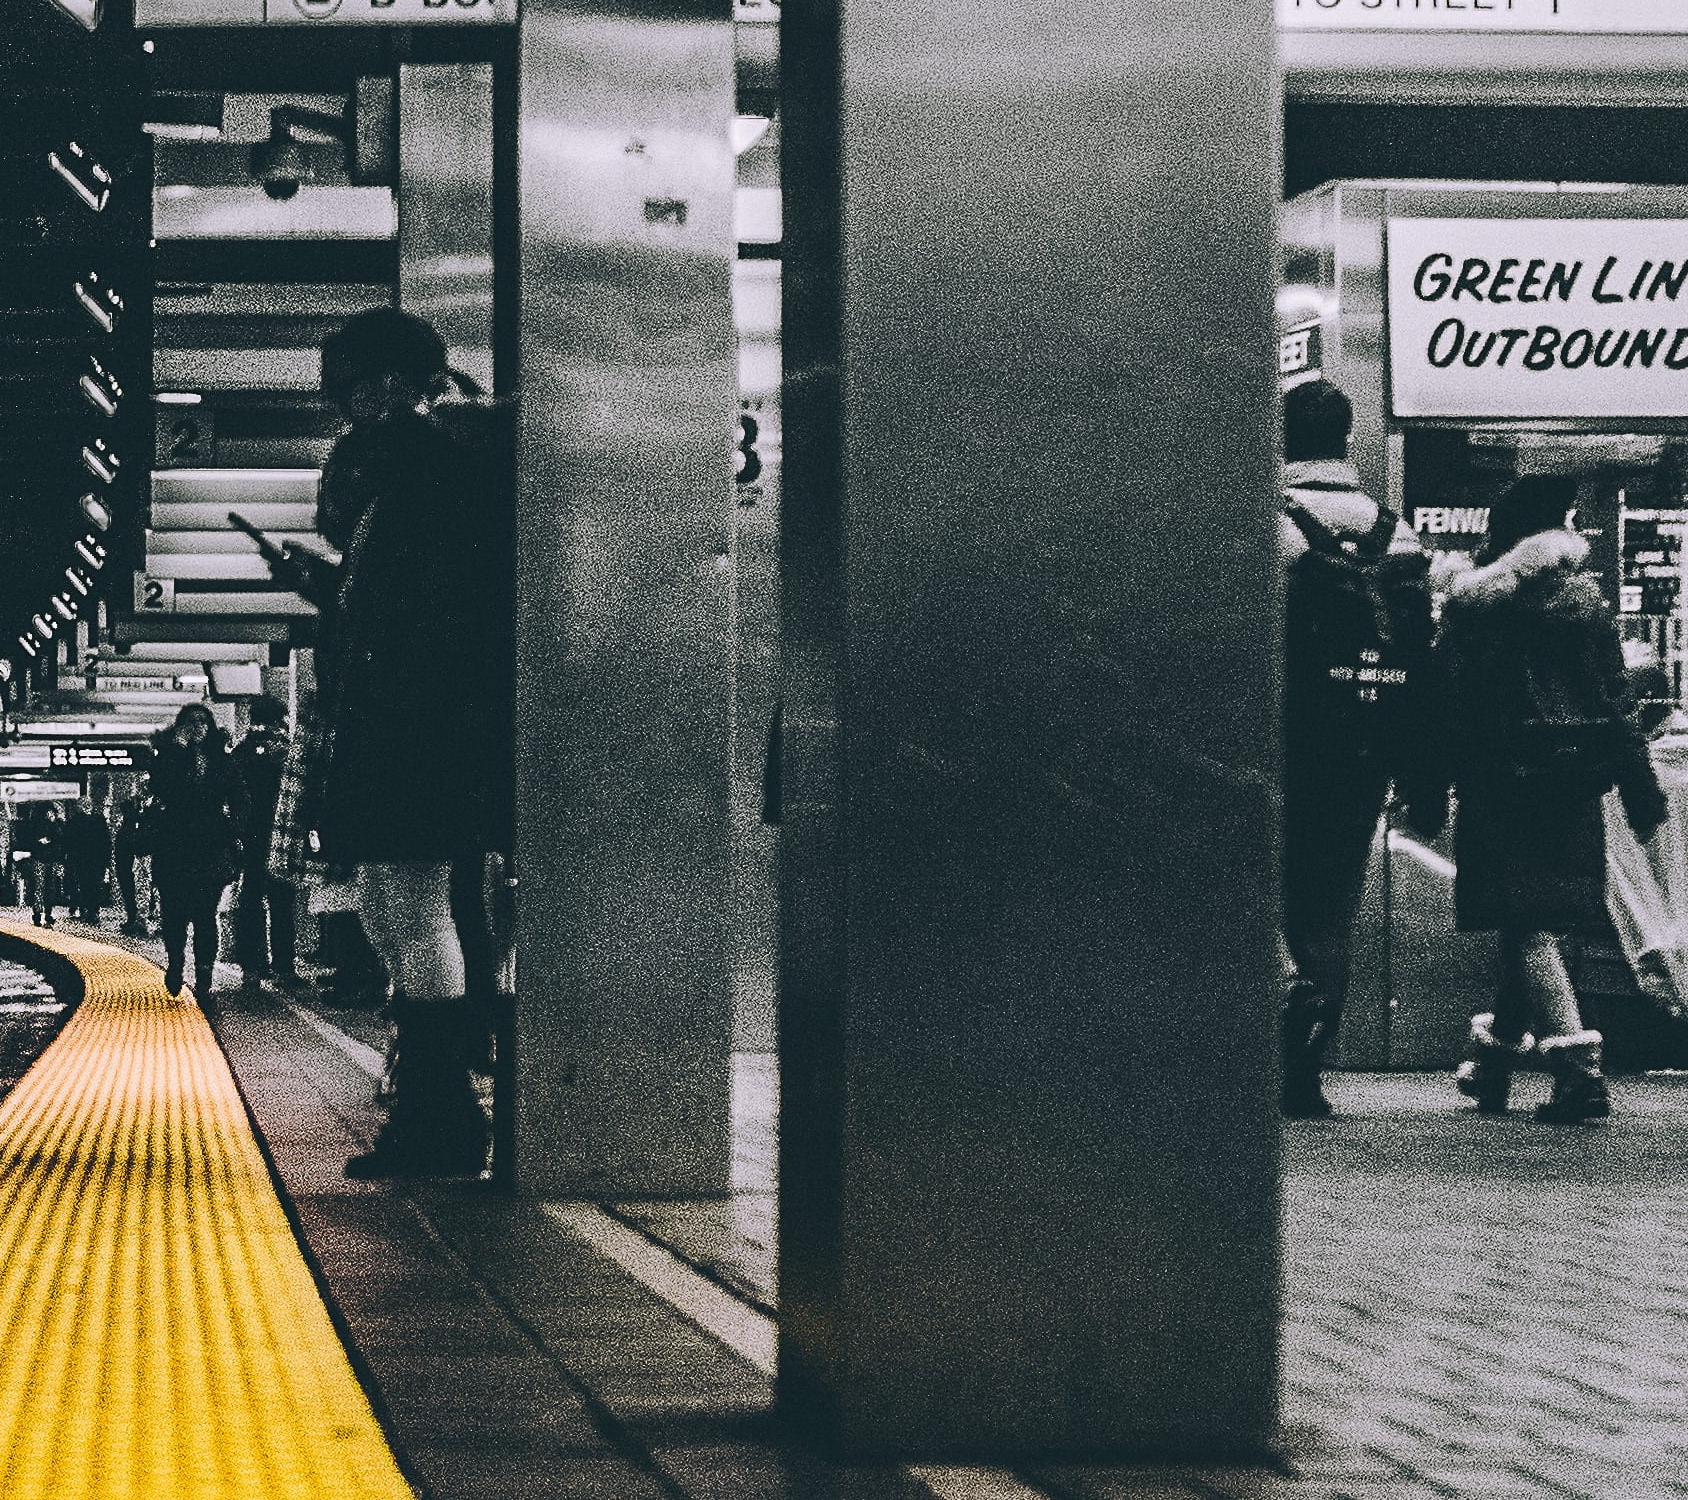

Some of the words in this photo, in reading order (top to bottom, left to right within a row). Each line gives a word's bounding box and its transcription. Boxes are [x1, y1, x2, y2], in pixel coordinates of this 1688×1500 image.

[1413, 252, 1583, 303] GREEN
[170, 419, 199, 458] 2
[143, 581, 165, 608] 2
